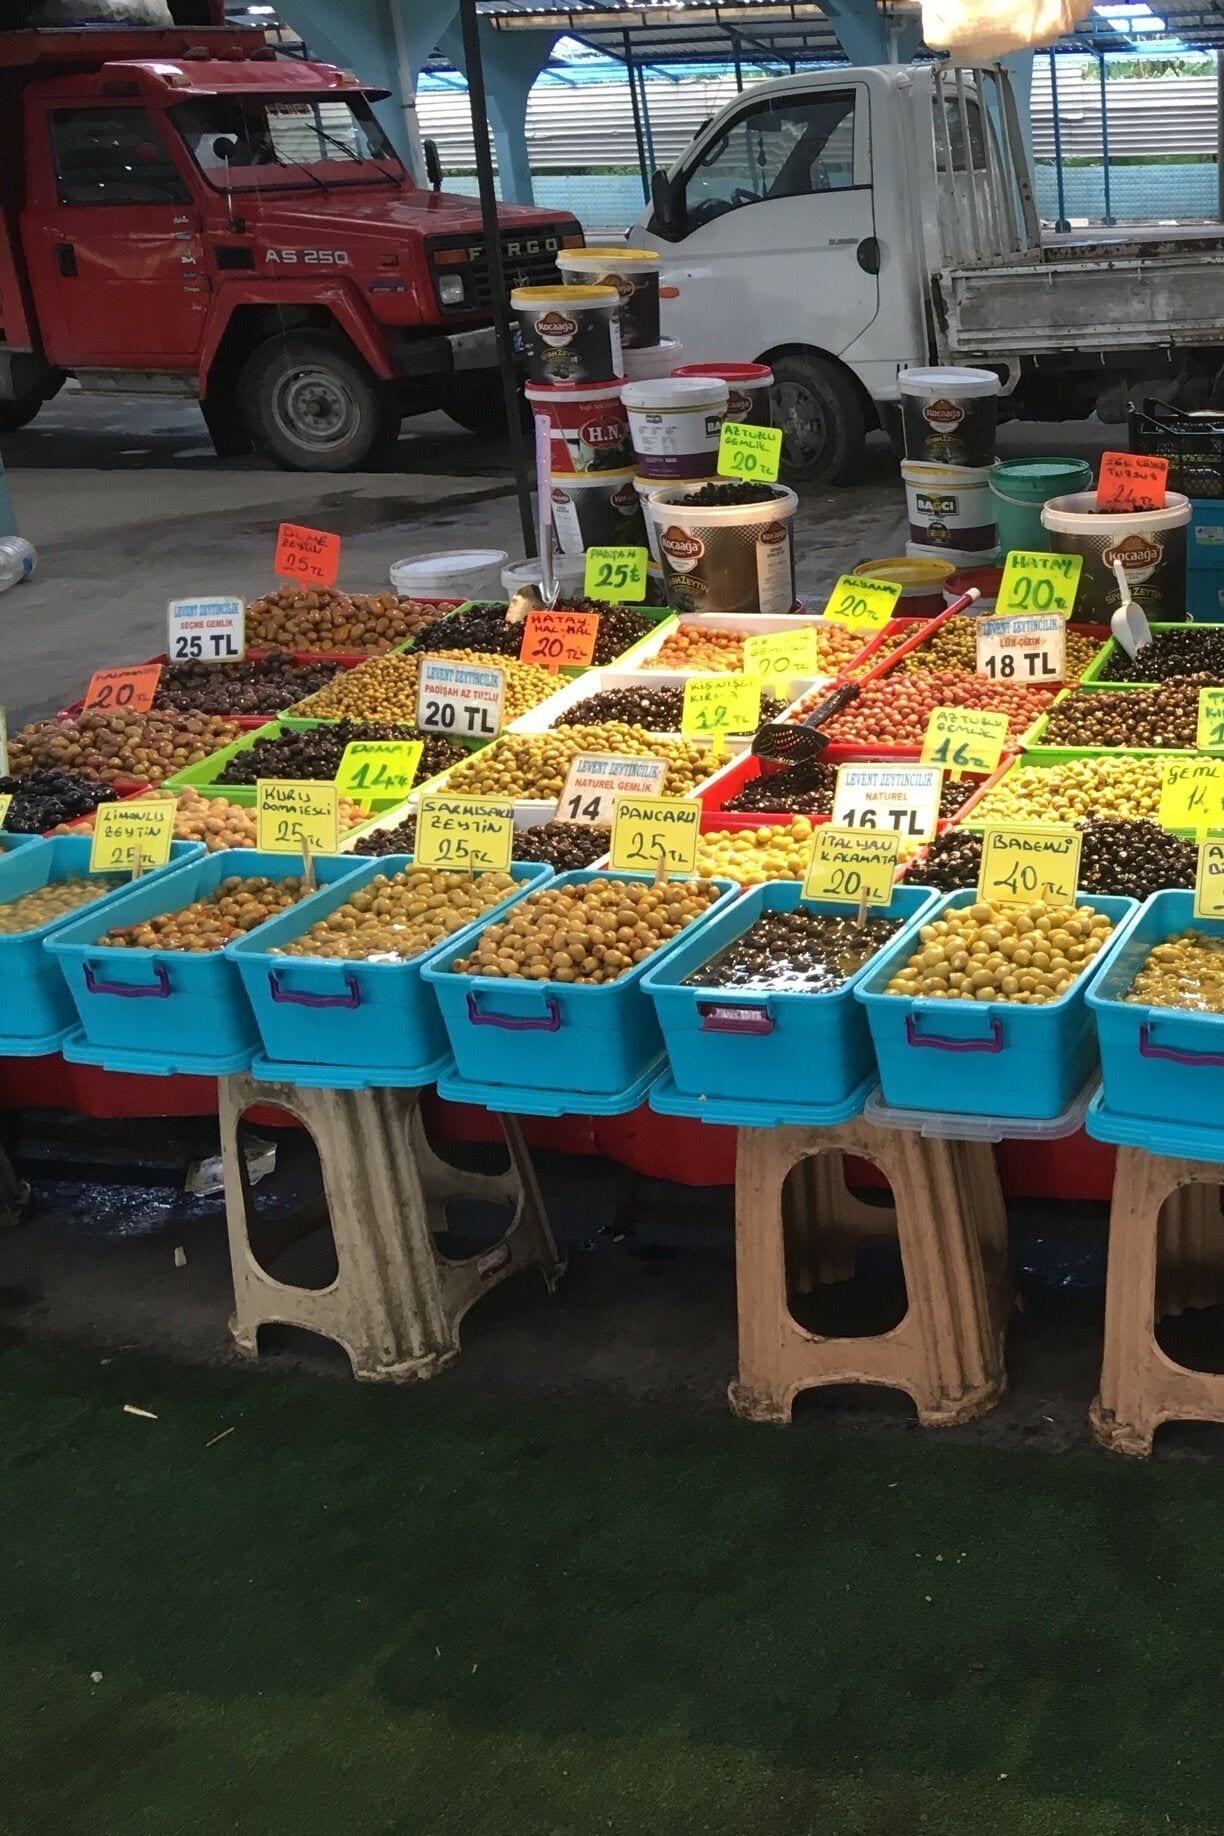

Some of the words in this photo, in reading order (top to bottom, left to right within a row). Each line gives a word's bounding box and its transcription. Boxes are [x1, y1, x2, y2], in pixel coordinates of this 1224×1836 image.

[265, 250, 298, 264] AS
[303, 250, 350, 265] 250
[470, 238, 558, 262] FRGO
[730, 450, 758, 472] 20
[1011, 555, 1073, 579] HATAY
[1008, 576, 1055, 610] 20
[834, 594, 868, 618] 20
[176, 635, 203, 659] 25
[209, 634, 239, 657] TL
[531, 636, 564, 658] 20
[427, 664, 453, 683] LEVENT
[985, 654, 1015, 679] 18
[1023, 651, 1057, 676] TL
[88, 683, 135, 709] 20
[425, 683, 459, 699] PADİŞAH
[460, 687, 472, 698] AZ
[473, 688, 500, 703] TUZLU
[424, 700, 456, 728] 20
[463, 705, 496, 734] TL
[931, 737, 967, 765] 16
[577, 759, 606, 775] LEVENT
[845, 771, 879, 787] LEVENT
[574, 777, 616, 791] NATUREL
[618, 779, 652, 793] GEMLİK
[865, 790, 909, 802] NATUREL
[567, 794, 601, 822] 14
[275, 819, 307, 844] 25
[842, 808, 876, 829] 16
[888, 809, 925, 836] TL
[110, 846, 136, 865] 25
[434, 838, 470, 864] 25
[626, 831, 667, 861] 25
[822, 867, 862, 896] 20
[992, 860, 1038, 895] 40
